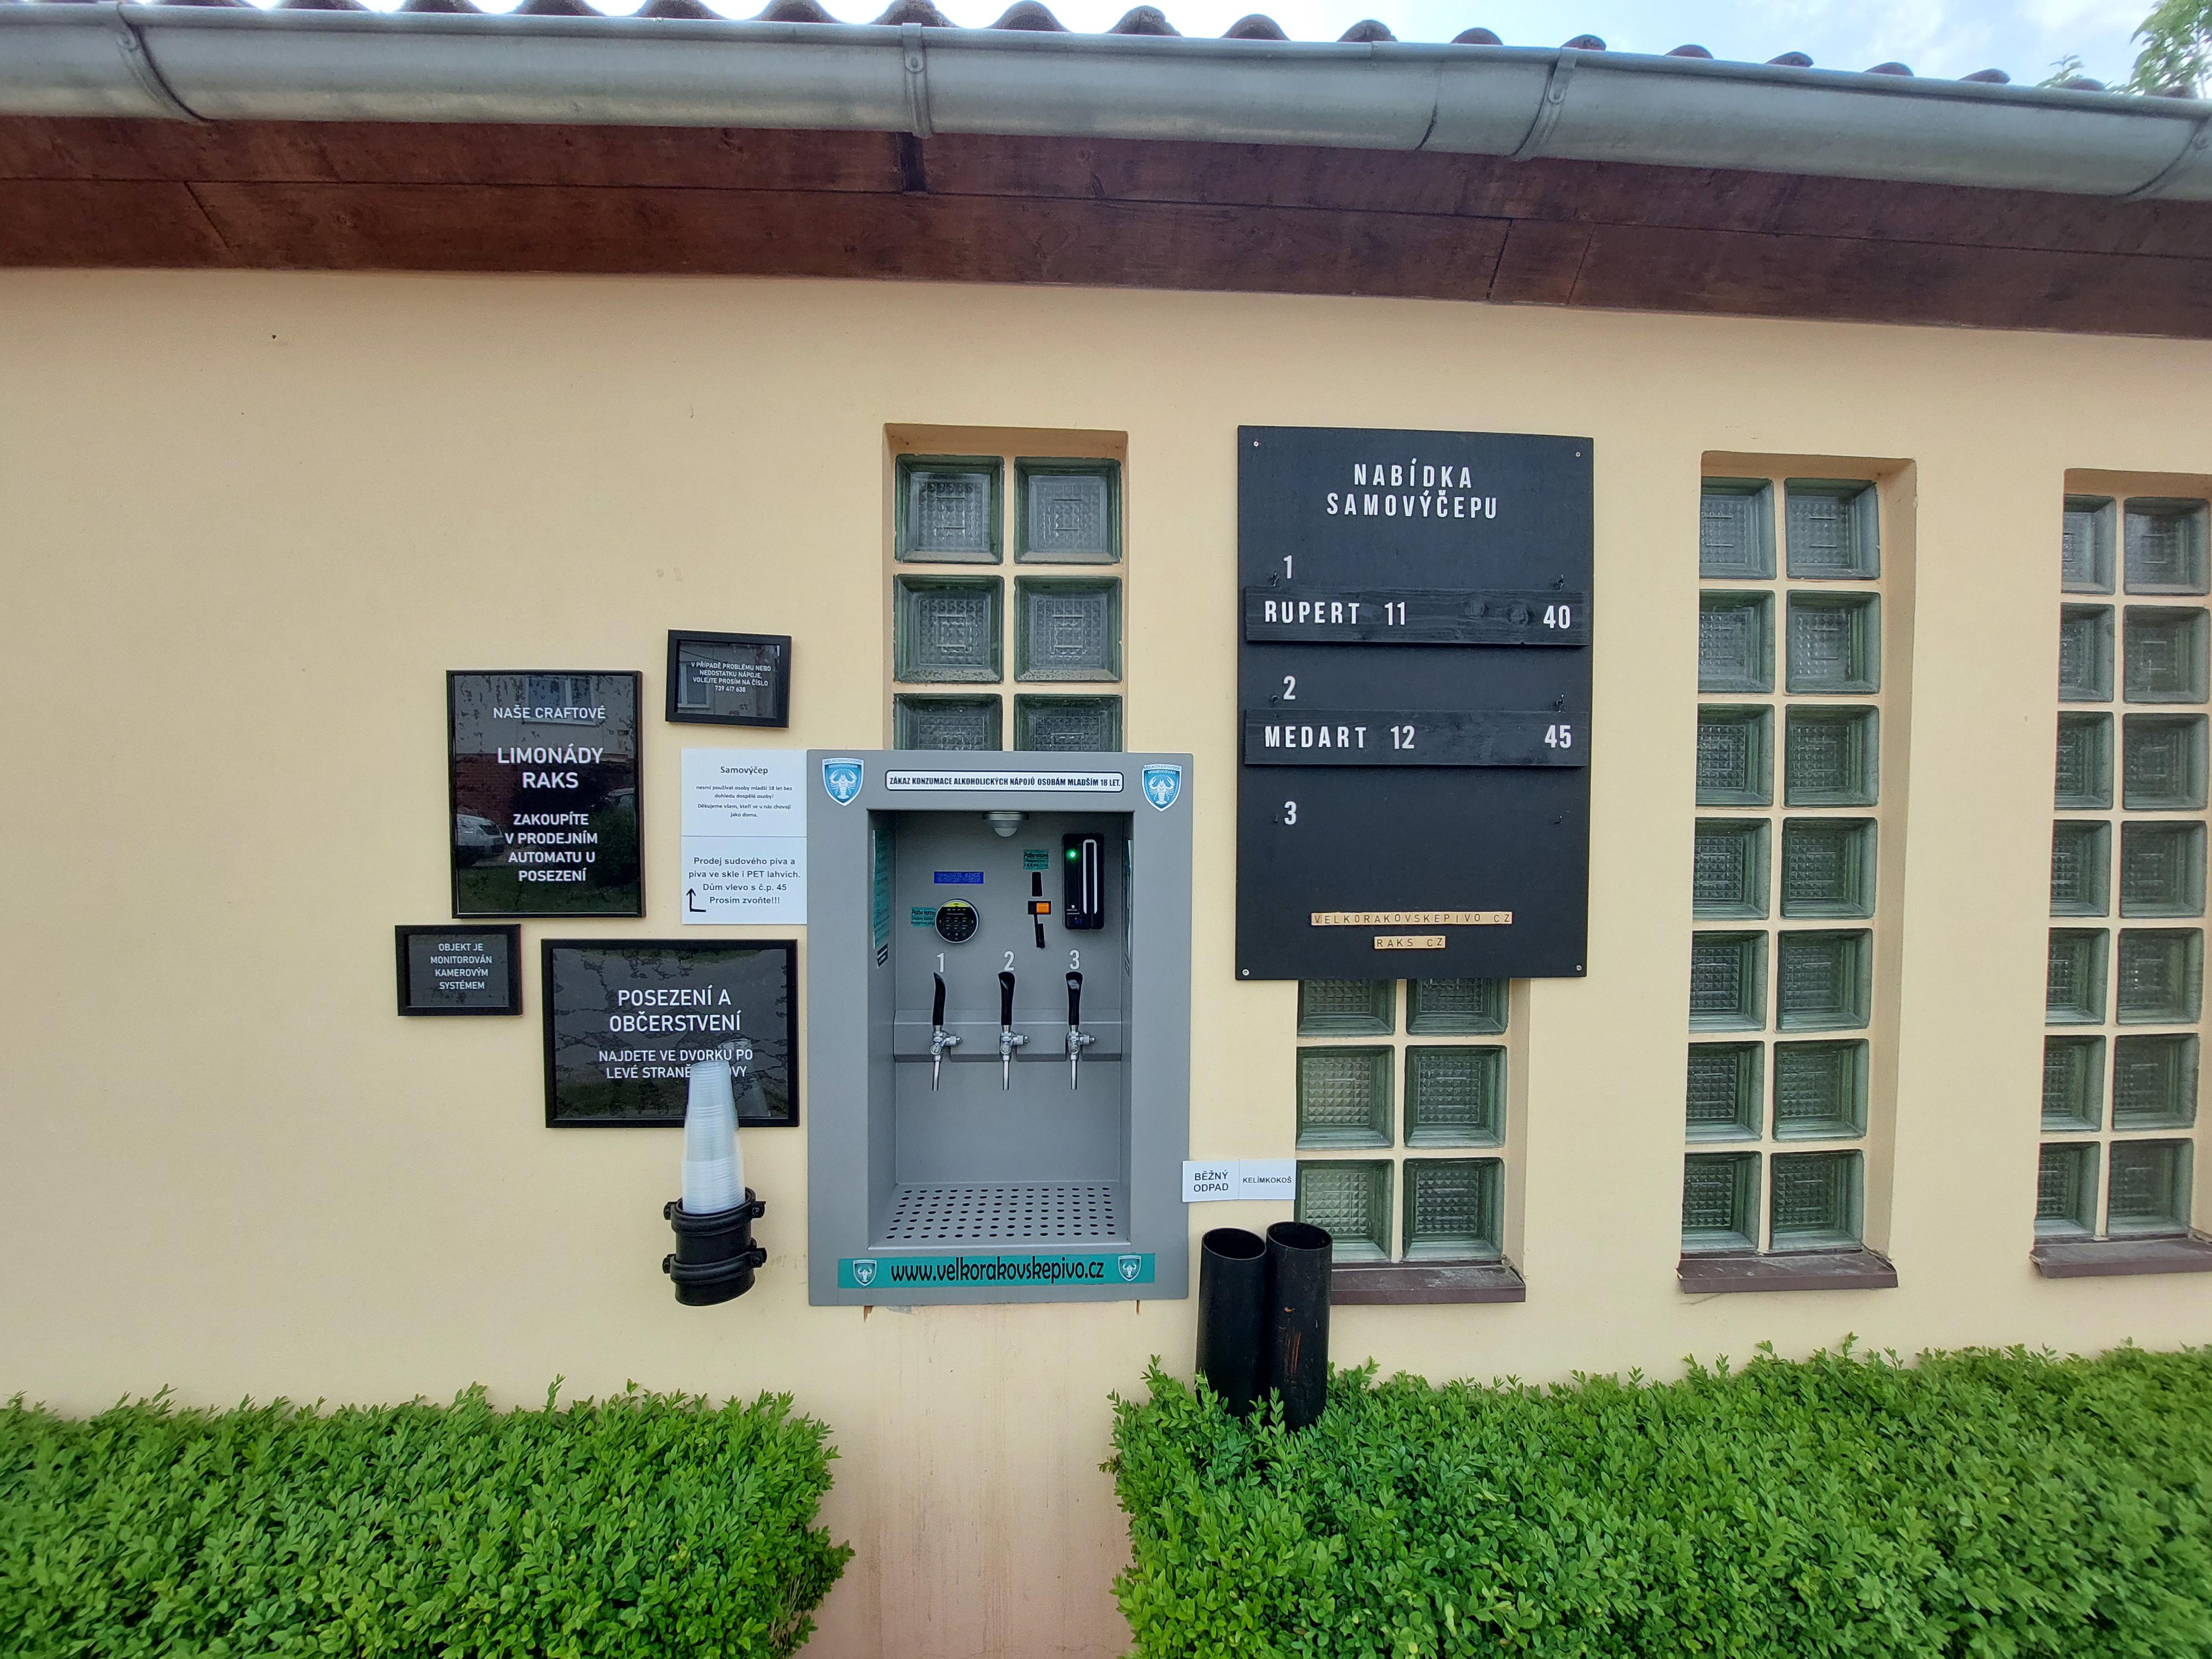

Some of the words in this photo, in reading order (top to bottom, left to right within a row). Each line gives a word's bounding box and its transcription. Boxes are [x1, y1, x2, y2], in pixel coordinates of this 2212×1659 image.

[1354, 458, 1472, 488] NABÍDKA
[1327, 489, 1497, 519] SAMOVÝČEPU
[1284, 555, 1292, 579] 1
[1265, 601, 1360, 624] RUPERT
[1384, 602, 1406, 625] 11
[1543, 605, 1571, 629] 40
[696, 660, 721, 669] PŘÍPADĚ
[1283, 676, 1296, 700] 2
[493, 705, 532, 719] NAŠE
[535, 705, 606, 719] CRAFTOVÉ
[1265, 726, 1366, 749] MEDART
[1390, 725, 1415, 749] 12
[1545, 725, 1572, 748] 45
[498, 744, 604, 764] LIMONÁDY
[720, 766, 768, 775] Samovýčep
[523, 772, 578, 789] RAKS
[889, 776, 911, 785] ZÁKAZ
[953, 776, 1008, 785] ALKOHOLICKÝCH
[1010, 776, 1035, 785] NÁPOJŮ
[1037, 777, 1066, 786] OSOBÁM
[1067, 777, 1099, 786] MLADŠÍM
[513, 812, 589, 826] ZAKOUPÍTE
[1284, 801, 1297, 825] 3
[505, 833, 514, 844] V
[518, 830, 598, 844] PRODEJNÍM
[508, 851, 582, 864] AUTOMATU
[586, 851, 596, 863] U
[694, 857, 722, 866] Prodej
[770, 858, 787, 866] piva
[519, 867, 586, 882] POSEZENÍ
[688, 870, 706, 879] piva
[759, 884, 774, 892] č.p.
[1314, 914, 1481, 924] VELKORAKOVSKEPIVO
[1493, 914, 1510, 924] CZ
[1376, 938, 1413, 947] RAKS
[1427, 938, 1443, 947] CZ
[430, 953, 492, 964] MONITOROVÁN
[936, 953, 945, 973] 1
[1004, 951, 1015, 971] 2
[1070, 950, 1081, 969] 3
[435, 967, 488, 977] KAMEROVÝM
[439, 979, 485, 990] SYSTÉMEM
[618, 985, 713, 1006] POSEZENÍ
[718, 989, 732, 1005] A
[609, 1010, 742, 1032] OBČERSTVENÍ
[599, 1050, 656, 1062] NAJDETE
[660, 1050, 676, 1061] VE
[680, 1049, 732, 1061] DVORKU
[736, 1048, 753, 1060] PO
[607, 1064, 638, 1079] LEVÉ
[642, 1063, 691, 1078] STRANĚ
[1194, 1170, 1229, 1181] BĚŽNÝ
[1243, 1175, 1292, 1184] KELÍMKOKOŠ
[1193, 1183, 1229, 1192] ODPAD
[891, 1255, 1105, 1285] www.velkorakovskepivo.cz
